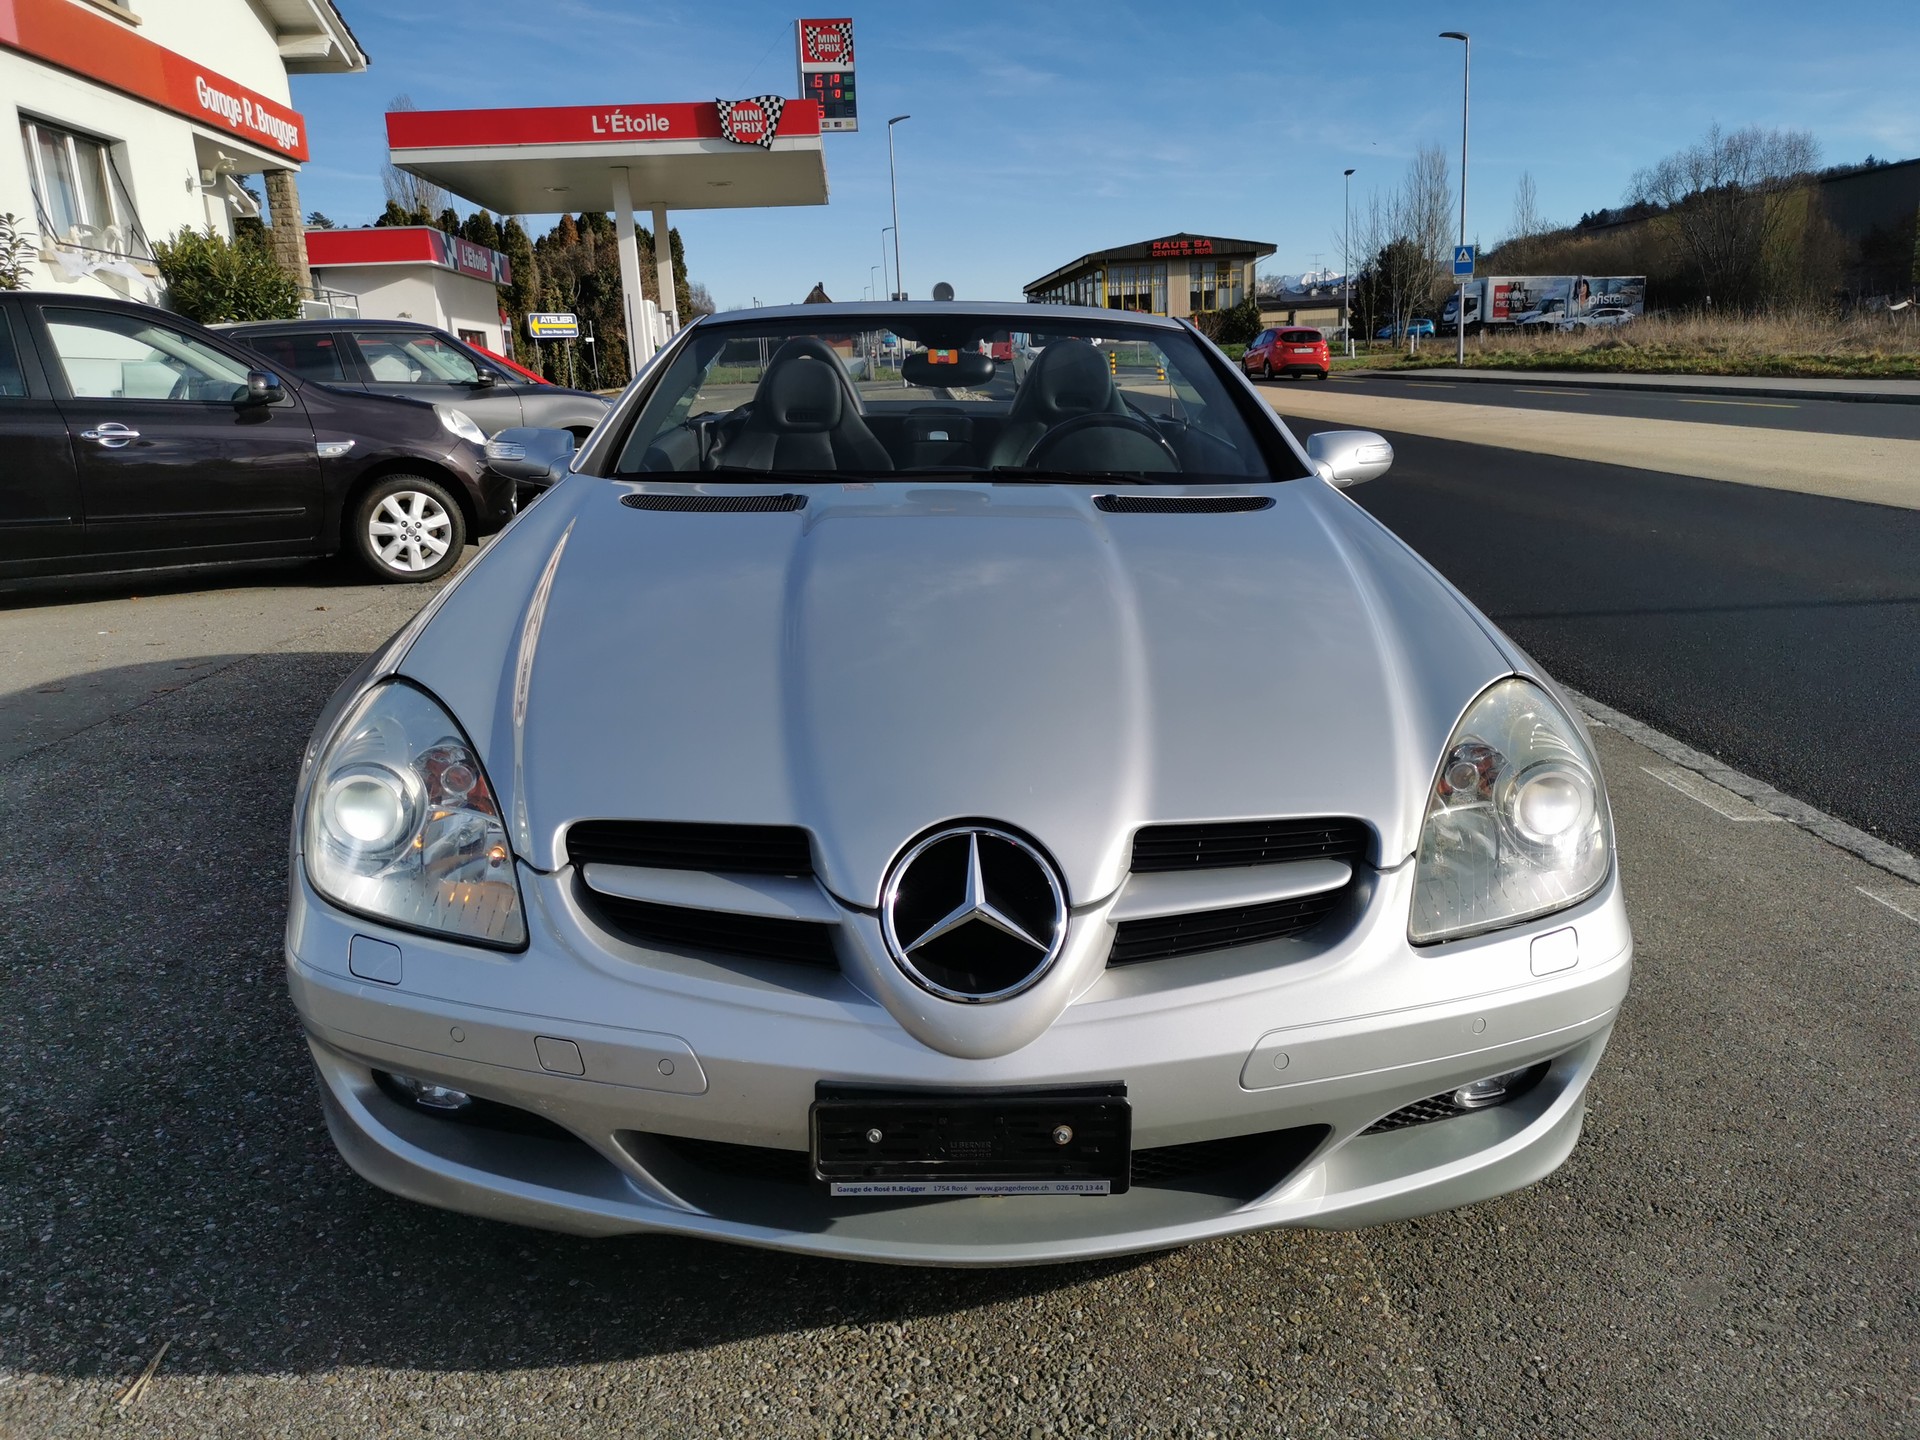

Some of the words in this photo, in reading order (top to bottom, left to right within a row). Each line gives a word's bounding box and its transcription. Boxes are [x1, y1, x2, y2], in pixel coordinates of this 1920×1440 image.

[817, 34, 841, 43] MINI
[818, 43, 841, 52] PRIX
[196, 75, 243, 128] Garage
[591, 108, 671, 134] L'Étoile
[731, 109, 763, 122] MINI
[732, 121, 764, 134] PRIX
[1153, 241, 1188, 249] RAUS
[1194, 239, 1211, 248] SA
[1588, 291, 1625, 309] pfister
[540, 316, 573, 324] ATELIER
[837, 1186, 862, 1194] Garage
[951, 1184, 968, 1192] Rosé
[975, 1184, 1049, 1193] www.garagederose.ch
